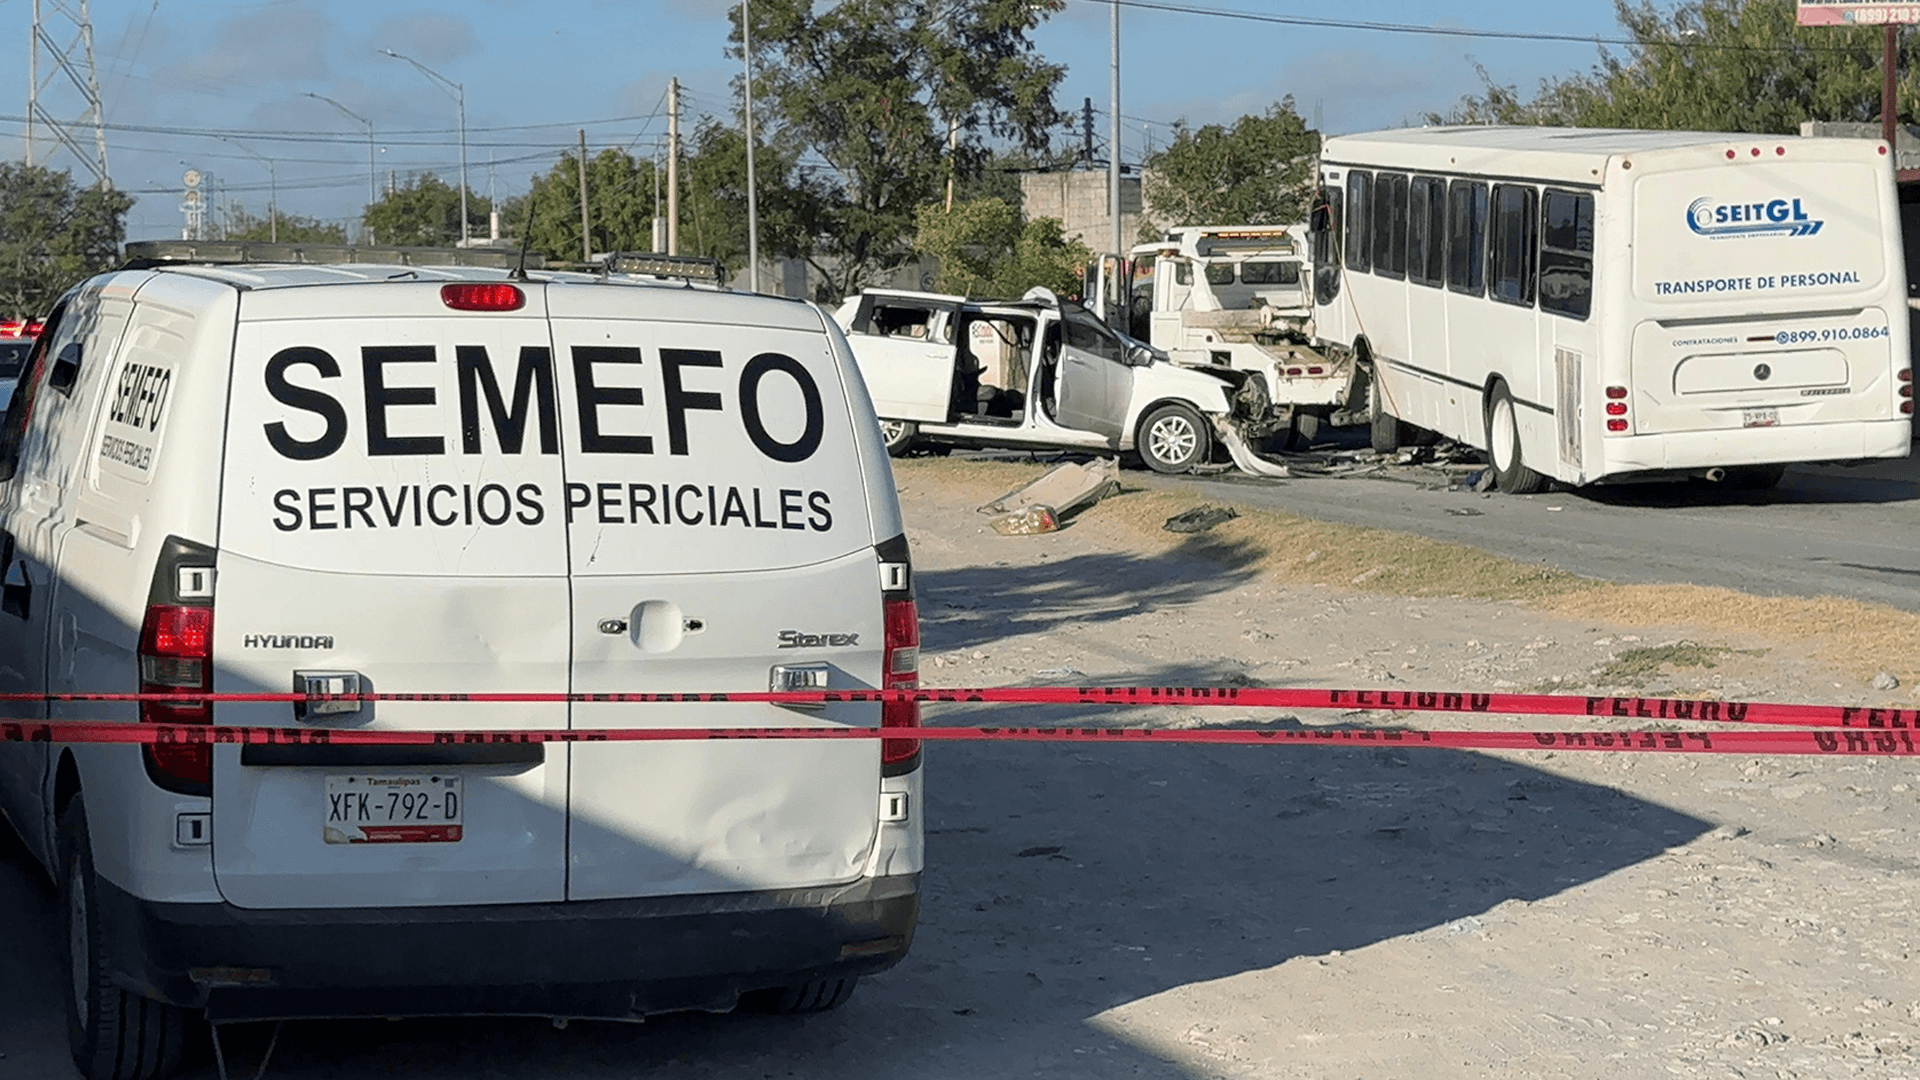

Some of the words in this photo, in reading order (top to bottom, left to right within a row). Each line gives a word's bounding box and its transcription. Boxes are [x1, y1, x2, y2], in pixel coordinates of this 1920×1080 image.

[1715, 198, 1808, 223] SEITGL
[1654, 277, 1752, 295] TRANSPORTE
[1757, 276, 1775, 289] DE
[1780, 271, 1860, 288] PERSONAL
[1672, 337, 1738, 347] CONTRATACIONES
[1789, 326, 1890, 343] 899.910.0864
[110, 362, 171, 433] SEMEFO
[264, 346, 823, 462] SEMEFO
[274, 484, 544, 532] SERVICIOS
[567, 482, 833, 532] PERICIALES
[244, 634, 334, 649] HYUNDAI
[777, 630, 860, 649] Starex
[367, 777, 421, 788] Tamaulipas
[329, 791, 458, 821] XFK-792-D
